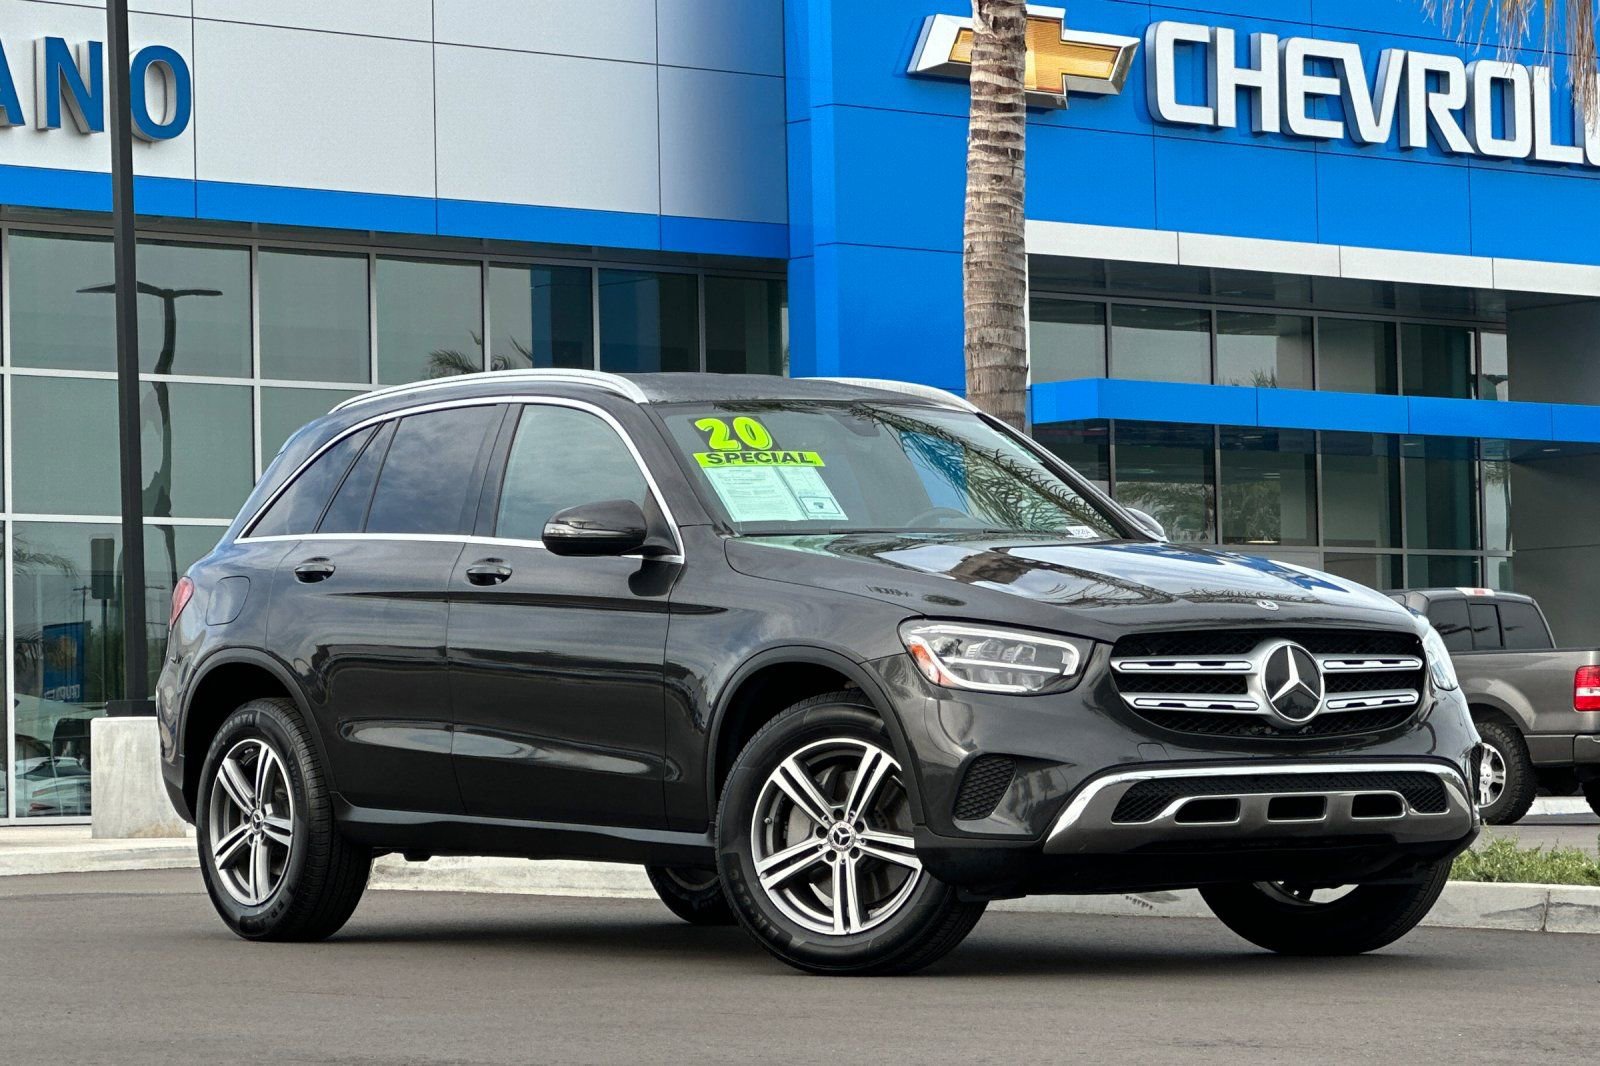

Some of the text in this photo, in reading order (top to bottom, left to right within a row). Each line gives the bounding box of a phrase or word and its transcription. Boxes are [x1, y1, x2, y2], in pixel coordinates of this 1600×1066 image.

[1145, 20, 1600, 166] CHEVROL
[694, 416, 773, 451] 20
[706, 452, 815, 465] SPECIAL
